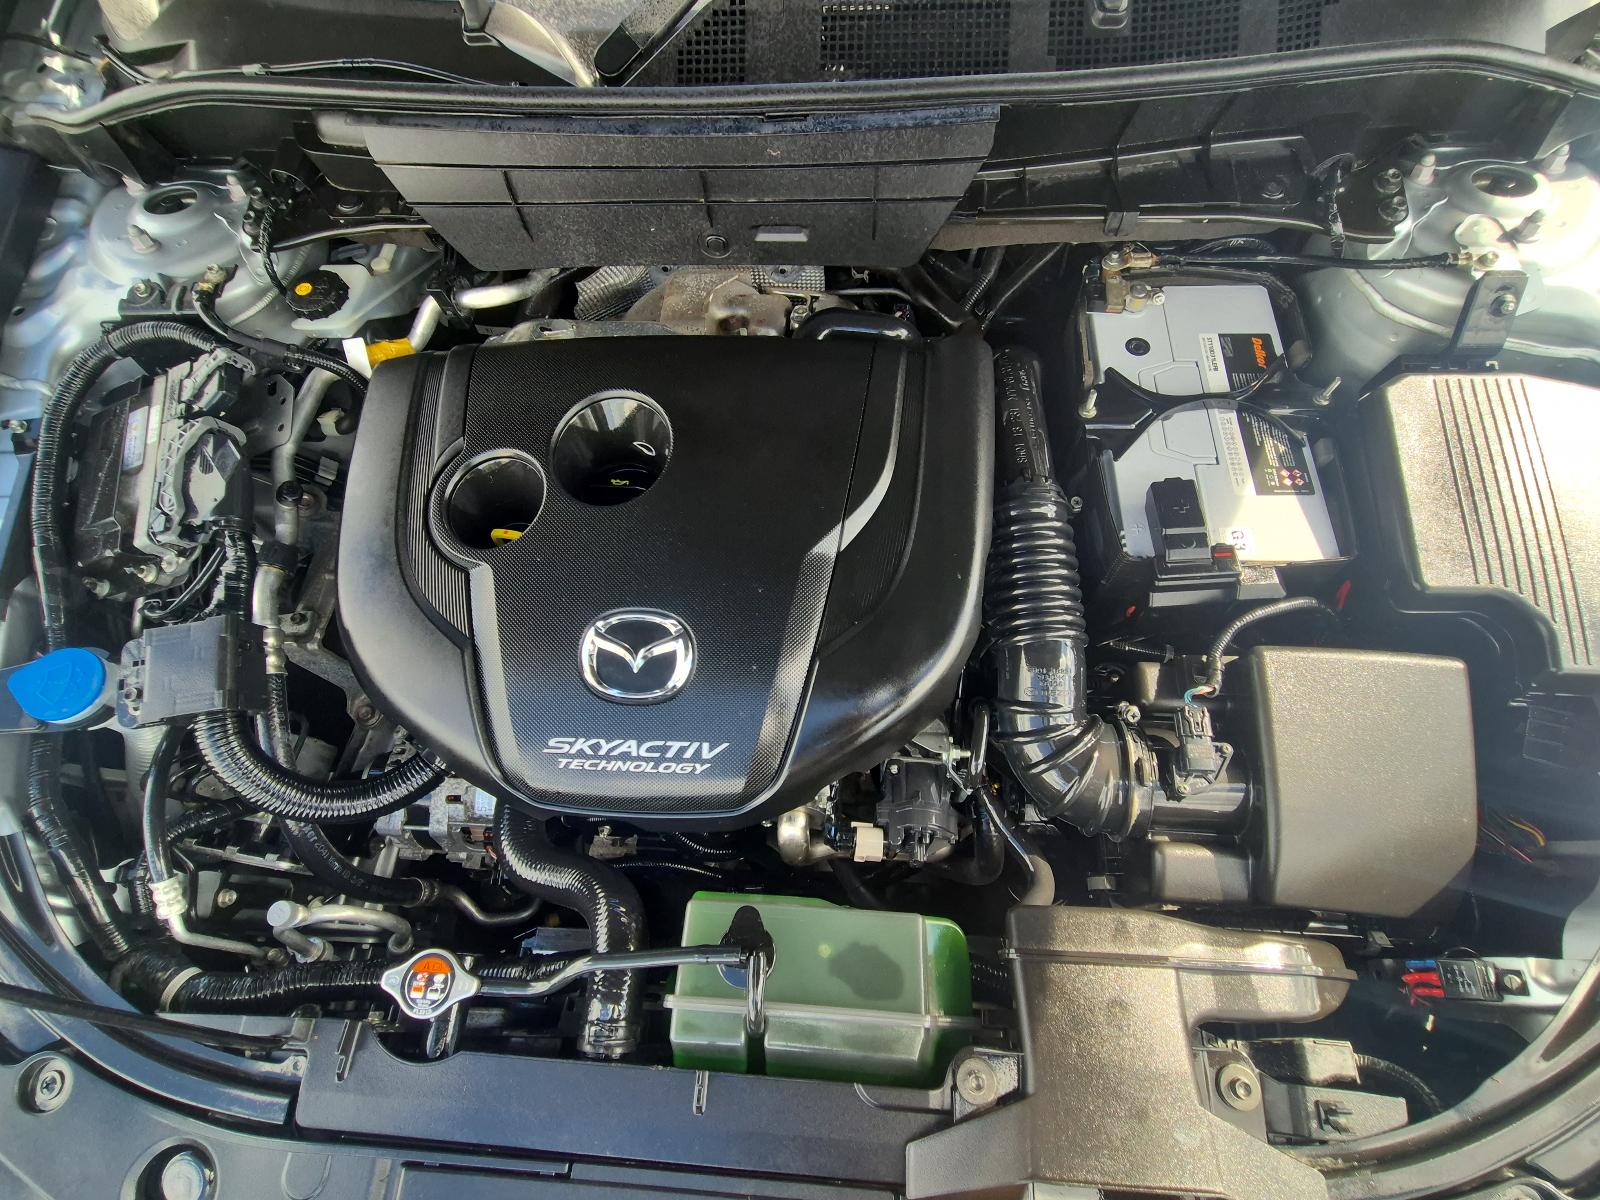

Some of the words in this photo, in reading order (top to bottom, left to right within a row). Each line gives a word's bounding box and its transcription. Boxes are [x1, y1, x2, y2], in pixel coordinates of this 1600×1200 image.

[1252, 336, 1267, 368] Delkor
[542, 738, 730, 759] SKYACTIV
[558, 758, 712, 775] TECHNOLOGY
